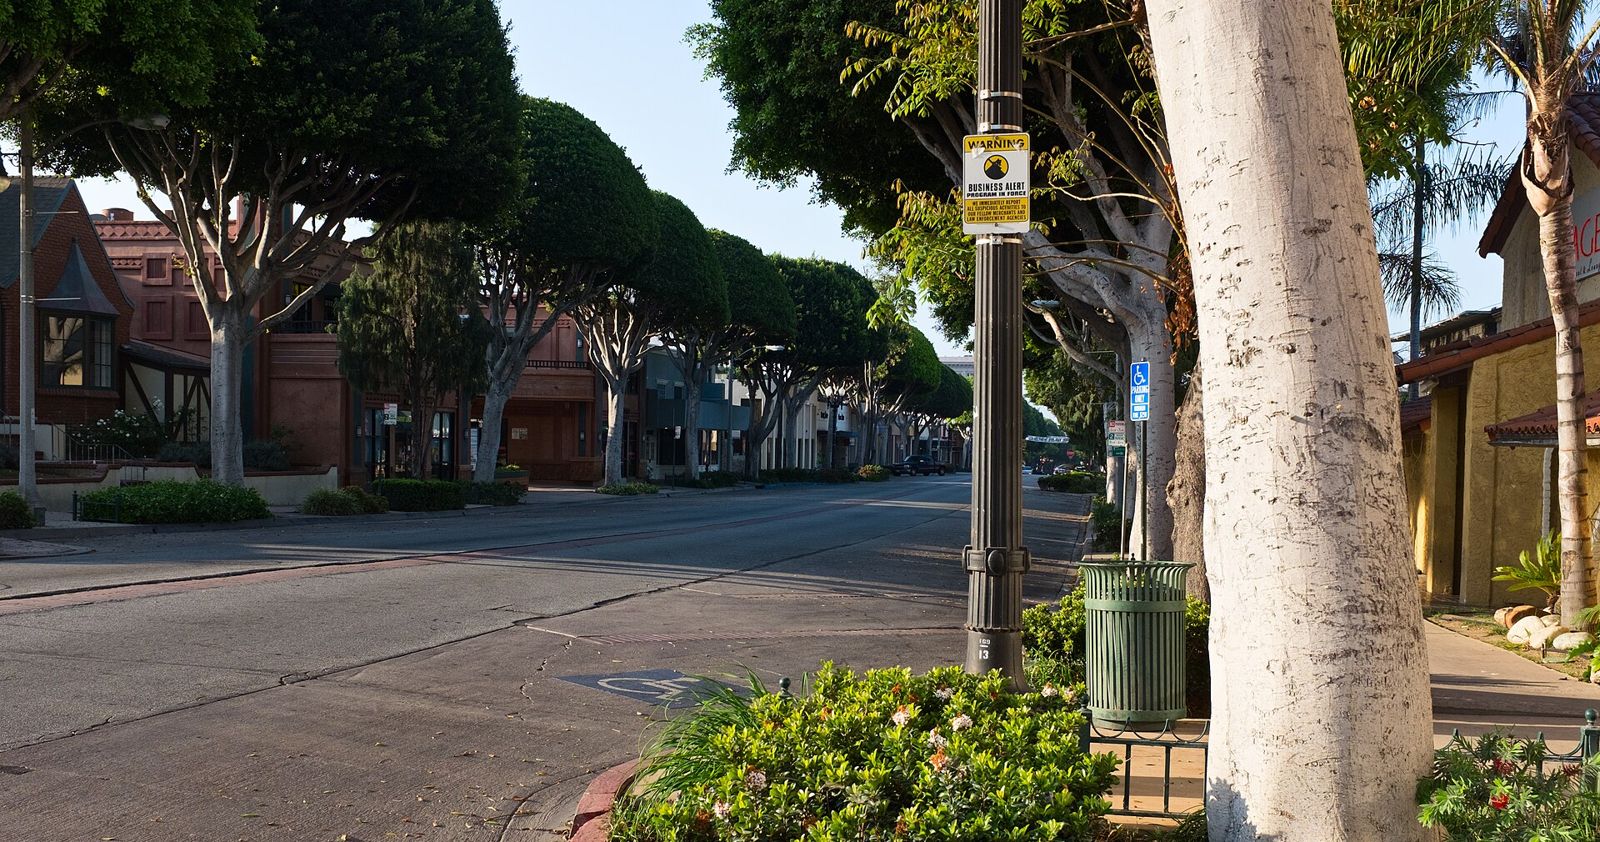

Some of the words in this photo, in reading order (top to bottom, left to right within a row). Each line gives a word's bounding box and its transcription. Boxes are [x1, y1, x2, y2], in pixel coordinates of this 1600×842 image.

[968, 139, 1024, 150] WARNING
[968, 182, 1003, 192] BUSINESS
[1006, 182, 1024, 190] ALERT
[1132, 385, 1148, 394] PARKING
[979, 650, 989, 660] 13
